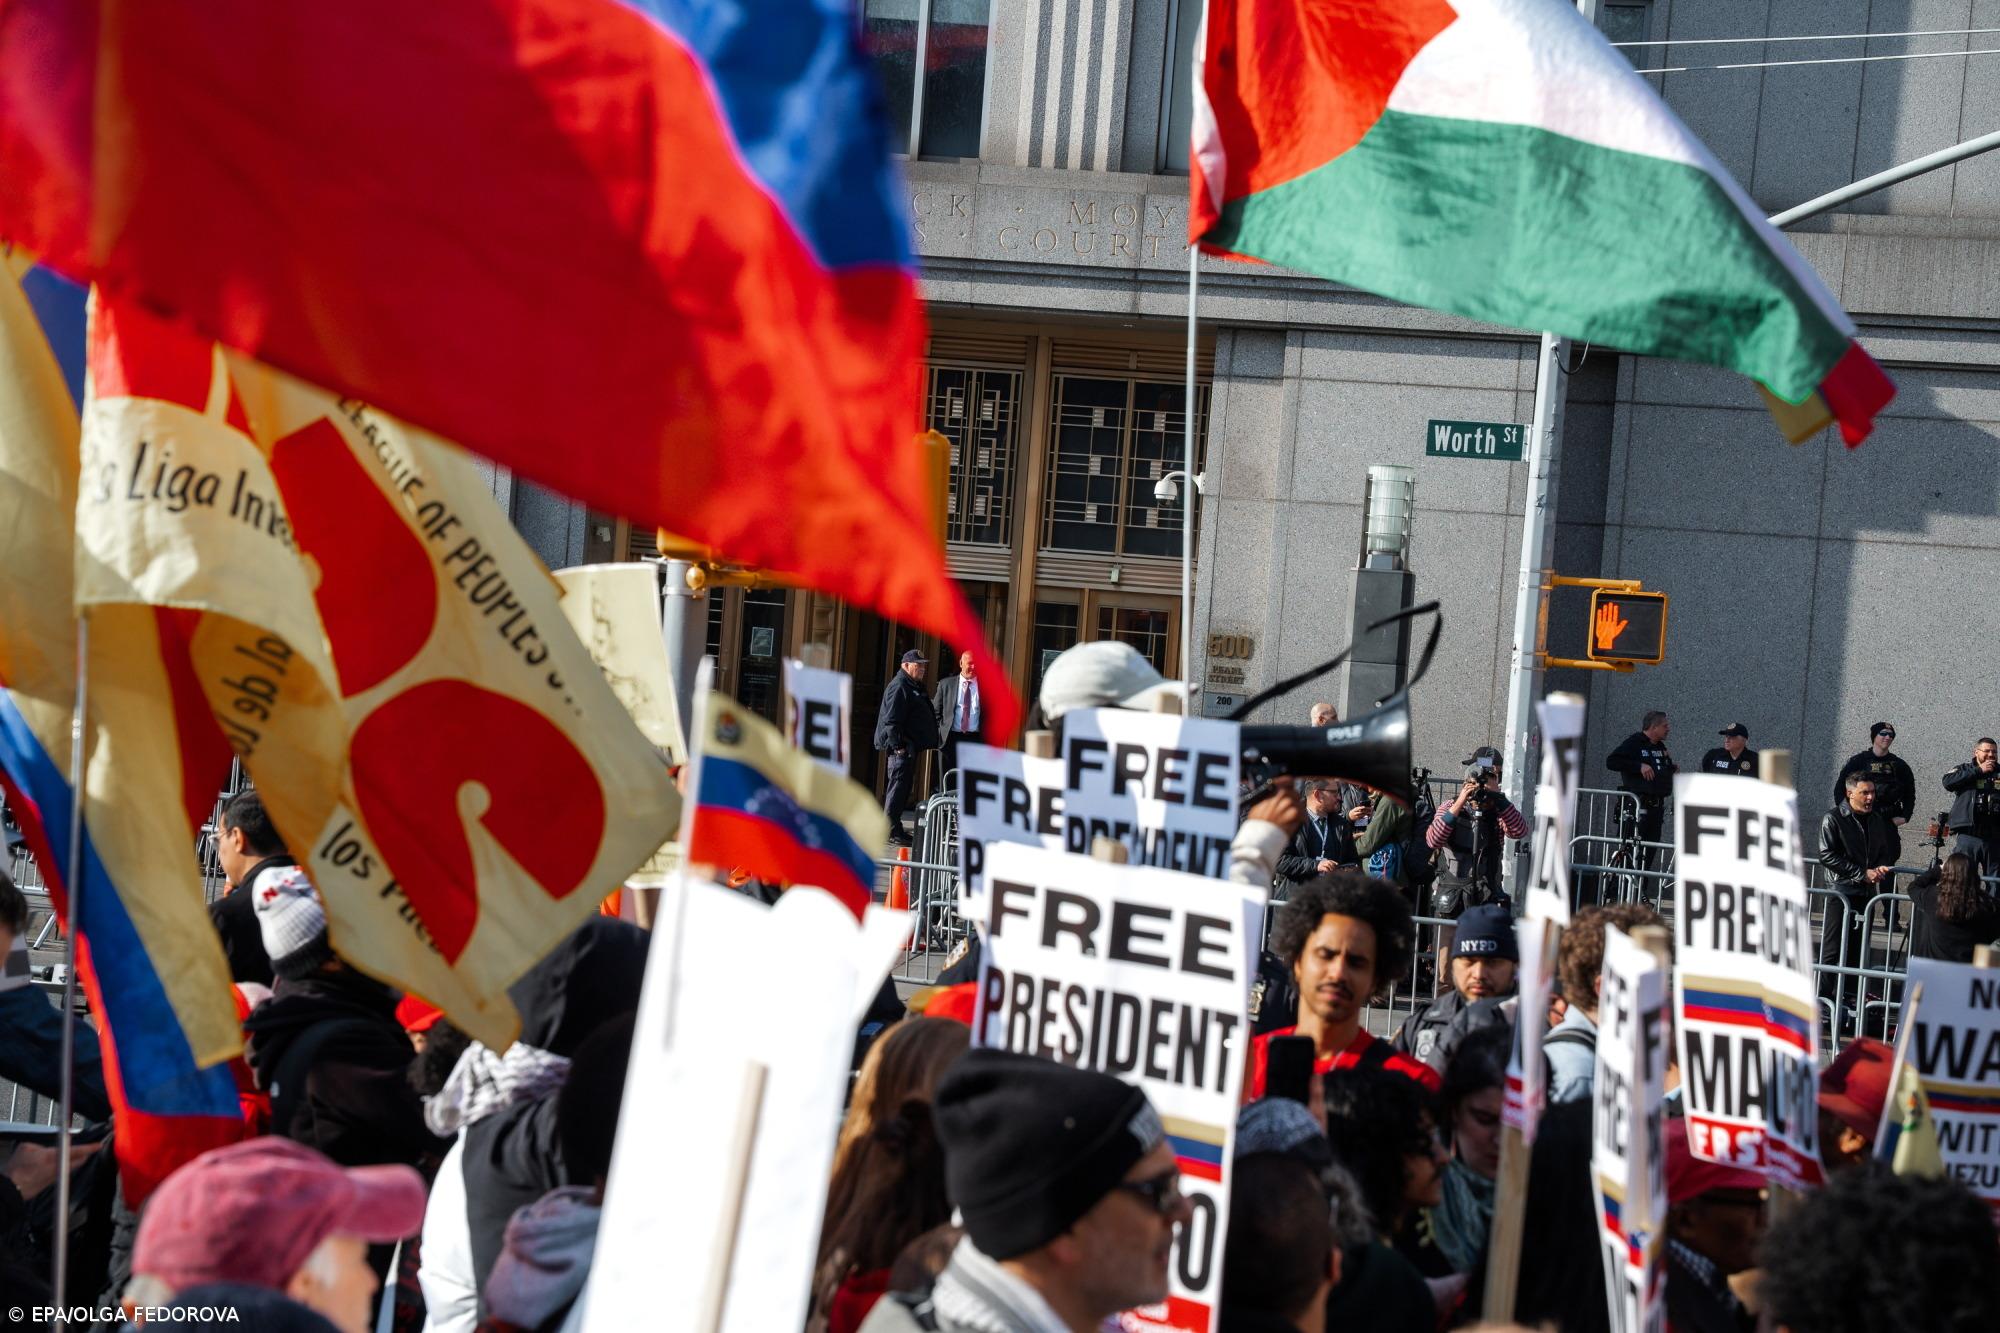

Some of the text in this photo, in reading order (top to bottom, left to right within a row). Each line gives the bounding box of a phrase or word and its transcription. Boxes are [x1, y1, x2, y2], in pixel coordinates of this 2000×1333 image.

[1000, 226, 1168, 259] COURT
[1434, 424, 1518, 455] Worth St
[126, 440, 221, 513] Liga
[1208, 633, 1250, 658] 500
[1216, 695, 1233, 706] 200
[1069, 737, 1231, 811] FREE
[320, 821, 377, 879] los
[989, 878, 1235, 982] FREE
[1460, 939, 1498, 953] NYPD
[1968, 977, 2000, 1011] N
[979, 964, 1239, 1095] PRESIDENT
